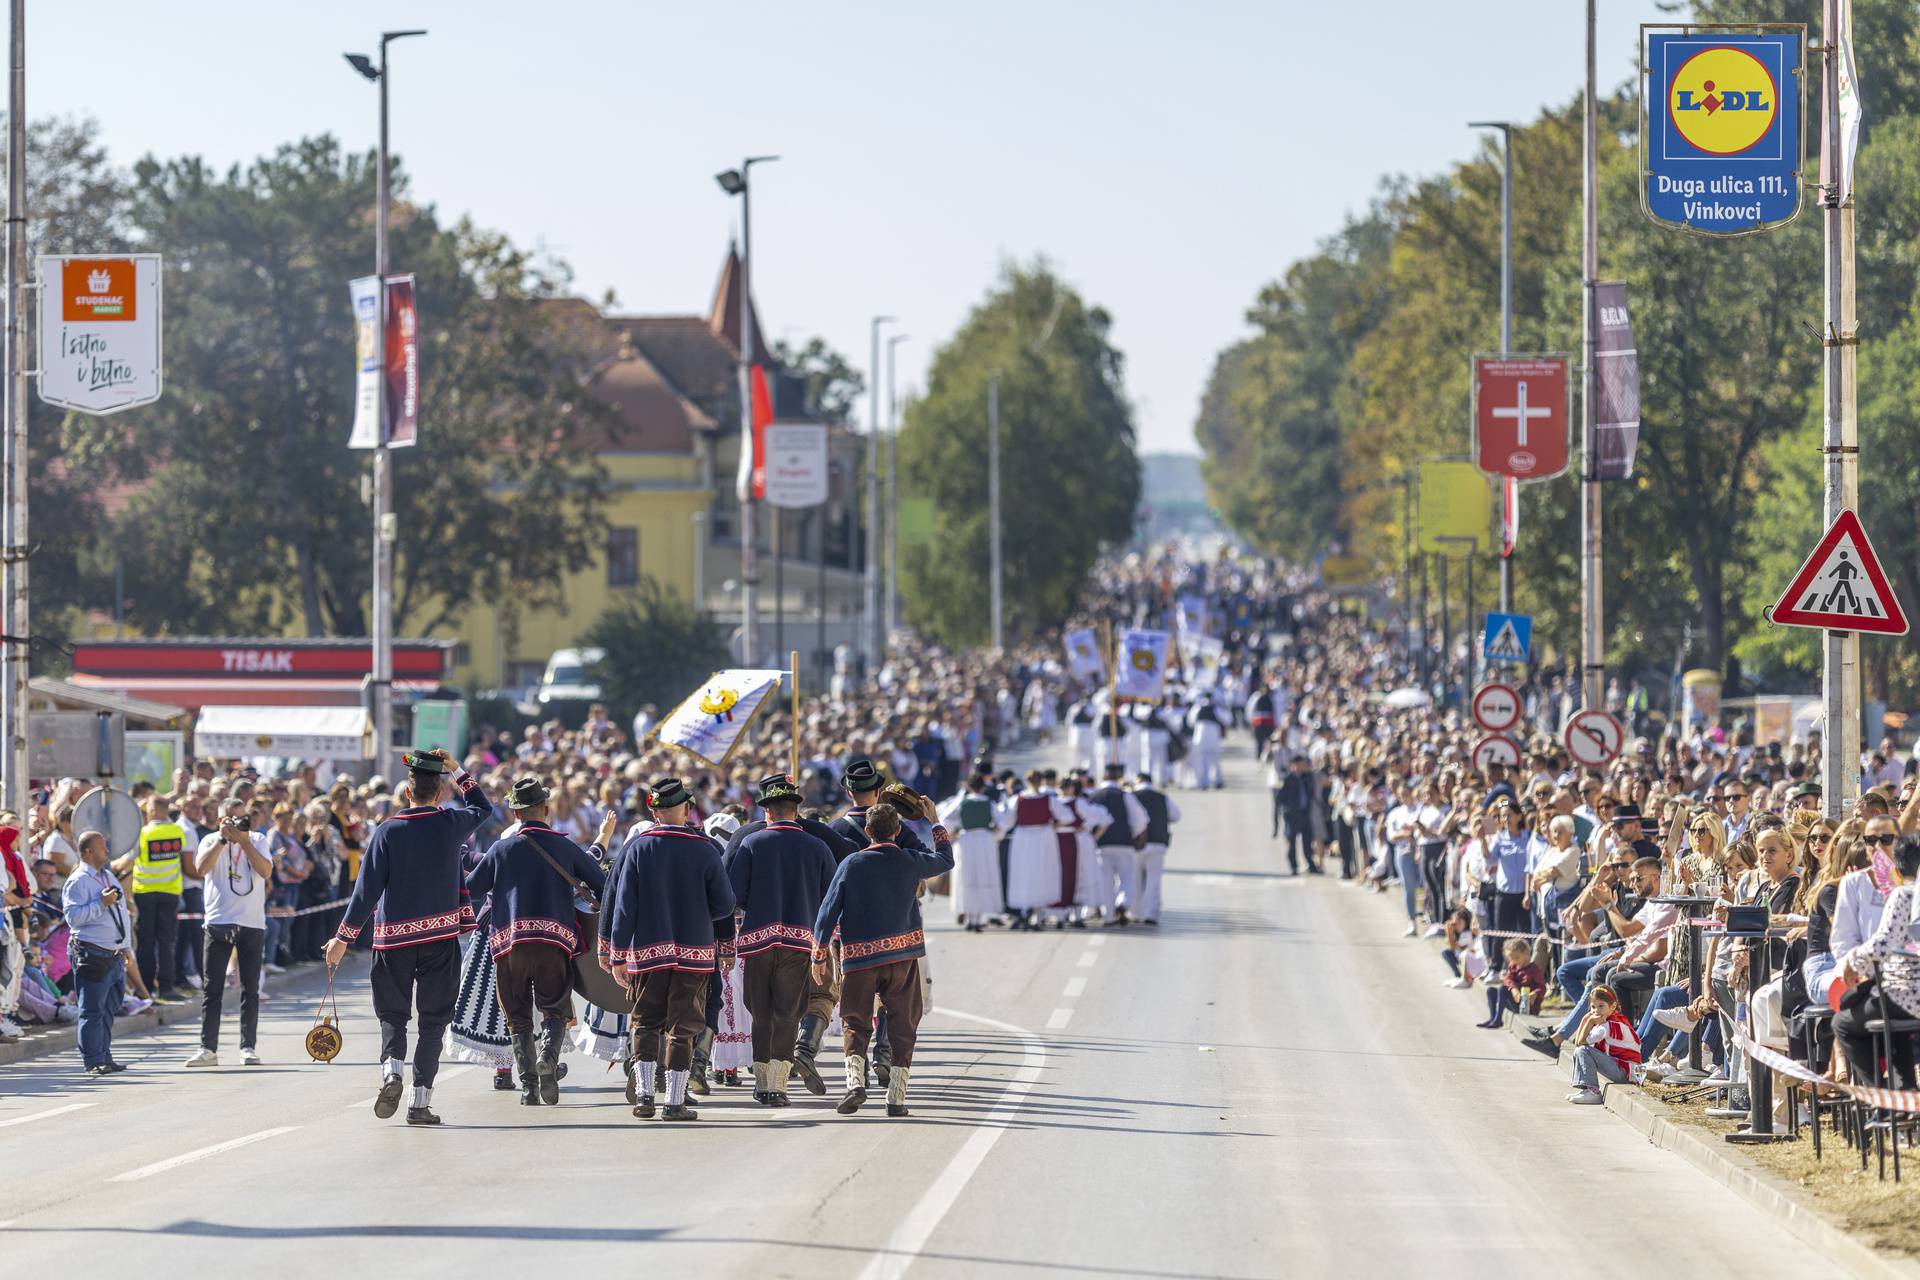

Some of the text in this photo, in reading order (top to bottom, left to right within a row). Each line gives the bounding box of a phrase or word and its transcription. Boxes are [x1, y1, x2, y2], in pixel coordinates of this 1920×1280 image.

[1657, 175, 1788, 198] Duga ulica 111,
[1683, 201, 1761, 220] Vinkovci
[75, 296, 124, 305] STUDENAC
[77, 361, 88, 383] i
[222, 650, 293, 672] TISAK
